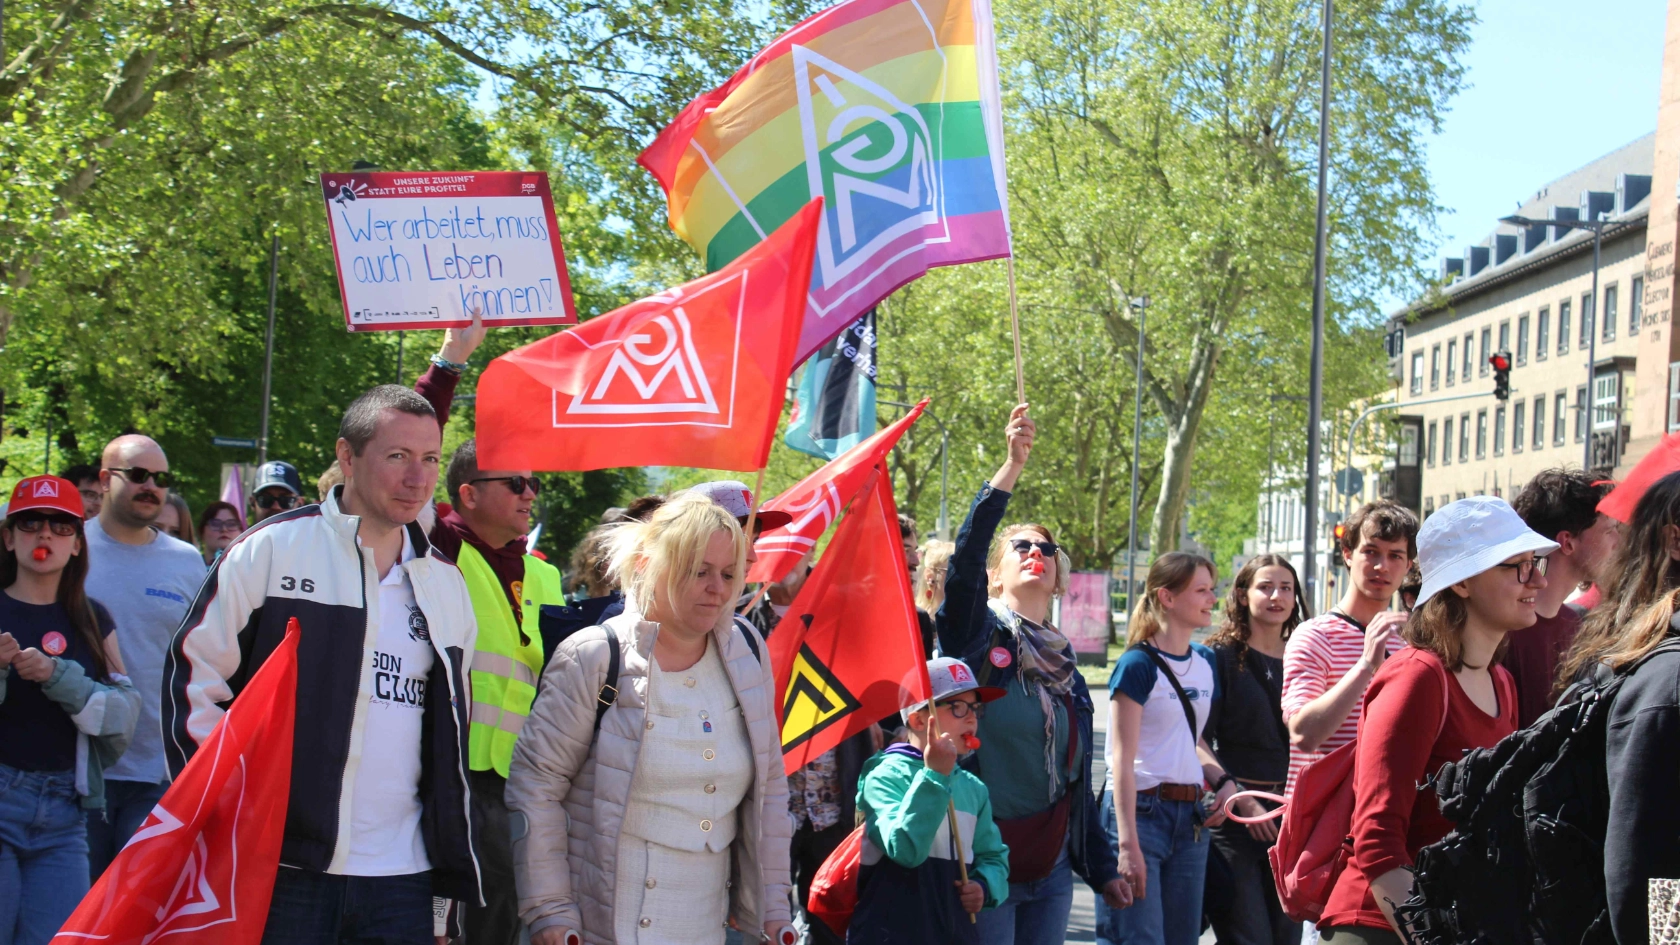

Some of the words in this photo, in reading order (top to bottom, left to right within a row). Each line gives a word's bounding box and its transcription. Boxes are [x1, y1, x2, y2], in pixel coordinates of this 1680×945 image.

[368, 187, 396, 196] STATT
[398, 186, 423, 195] EURE
[424, 184, 467, 194] PROFITE!
[393, 177, 430, 186] UNSERE
[432, 175, 475, 184] ZUKUNFT
[341, 208, 397, 243] Wer
[403, 205, 495, 243] arbeitet,
[496, 215, 548, 242] muss
[353, 245, 412, 283] auch
[423, 242, 503, 281] Leben
[280, 575, 316, 593] 36
[375, 671, 425, 707] CLUB
